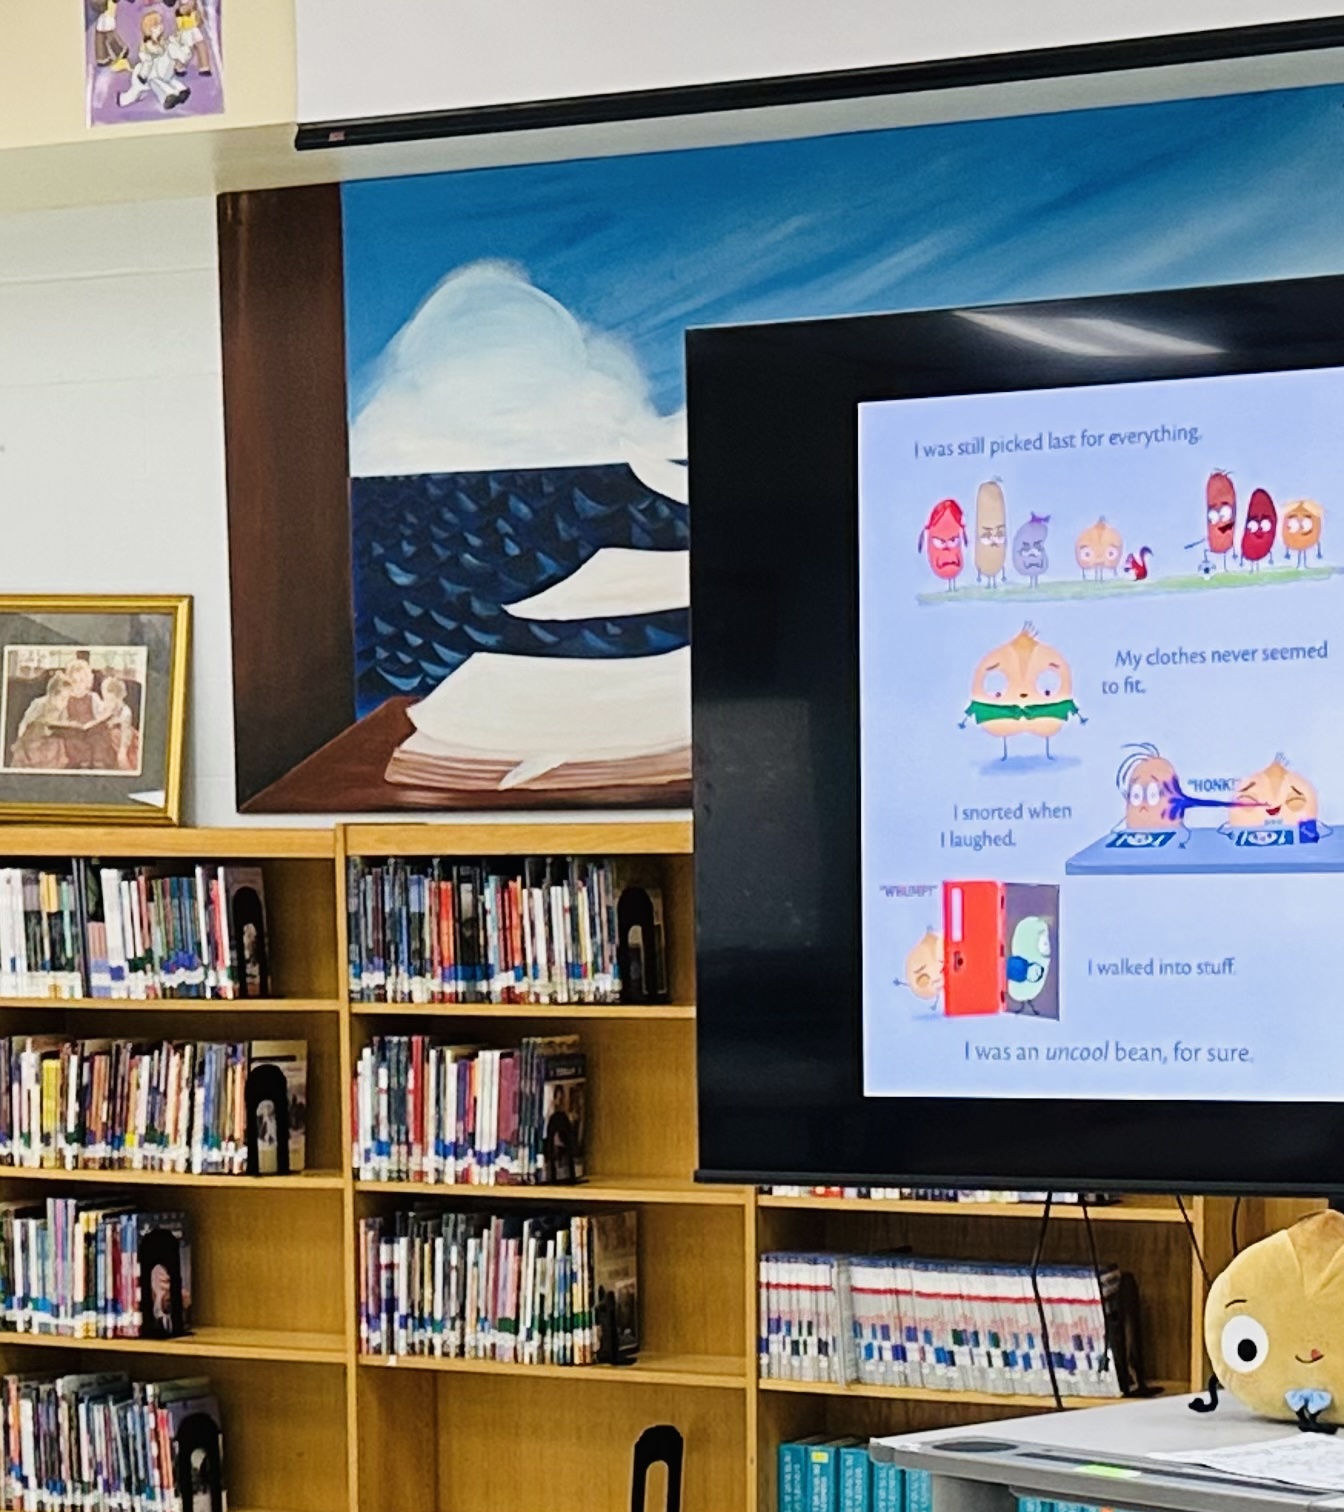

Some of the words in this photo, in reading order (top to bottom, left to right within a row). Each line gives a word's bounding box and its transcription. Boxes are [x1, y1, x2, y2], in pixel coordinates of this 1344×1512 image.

[914, 442, 918, 458] I
[924, 439, 953, 457] was
[957, 436, 985, 455] still
[990, 433, 1042, 456] picked
[1048, 432, 1076, 450] last
[1081, 429, 1105, 447] for
[1109, 425, 1202, 447] everything.
[1115, 649, 1142, 669] My
[1146, 647, 1206, 665] clothes
[1211, 649, 1257, 663] never
[1262, 642, 1327, 660] seemed
[1102, 680, 1119, 694] to
[1123, 678, 1146, 694] fit.
[954, 805, 957, 820] I
[962, 804, 1024, 820] snorted
[1028, 804, 1072, 819] when
[941, 834, 944, 847] I
[950, 830, 1016, 851] laughed.
[1088, 961, 1092, 974] I
[1097, 959, 1154, 975] walked
[1159, 959, 1192, 975] into
[1196, 957, 1236, 975] stuff.
[965, 1042, 969, 1060] I
[976, 1046, 1010, 1060] was
[1015, 1047, 1039, 1060] an
[1045, 1042, 1109, 1061] uncool
[1114, 1042, 1167, 1064] bean,
[1173, 1042, 1202, 1062] for
[1207, 1047, 1254, 1061] sure.
